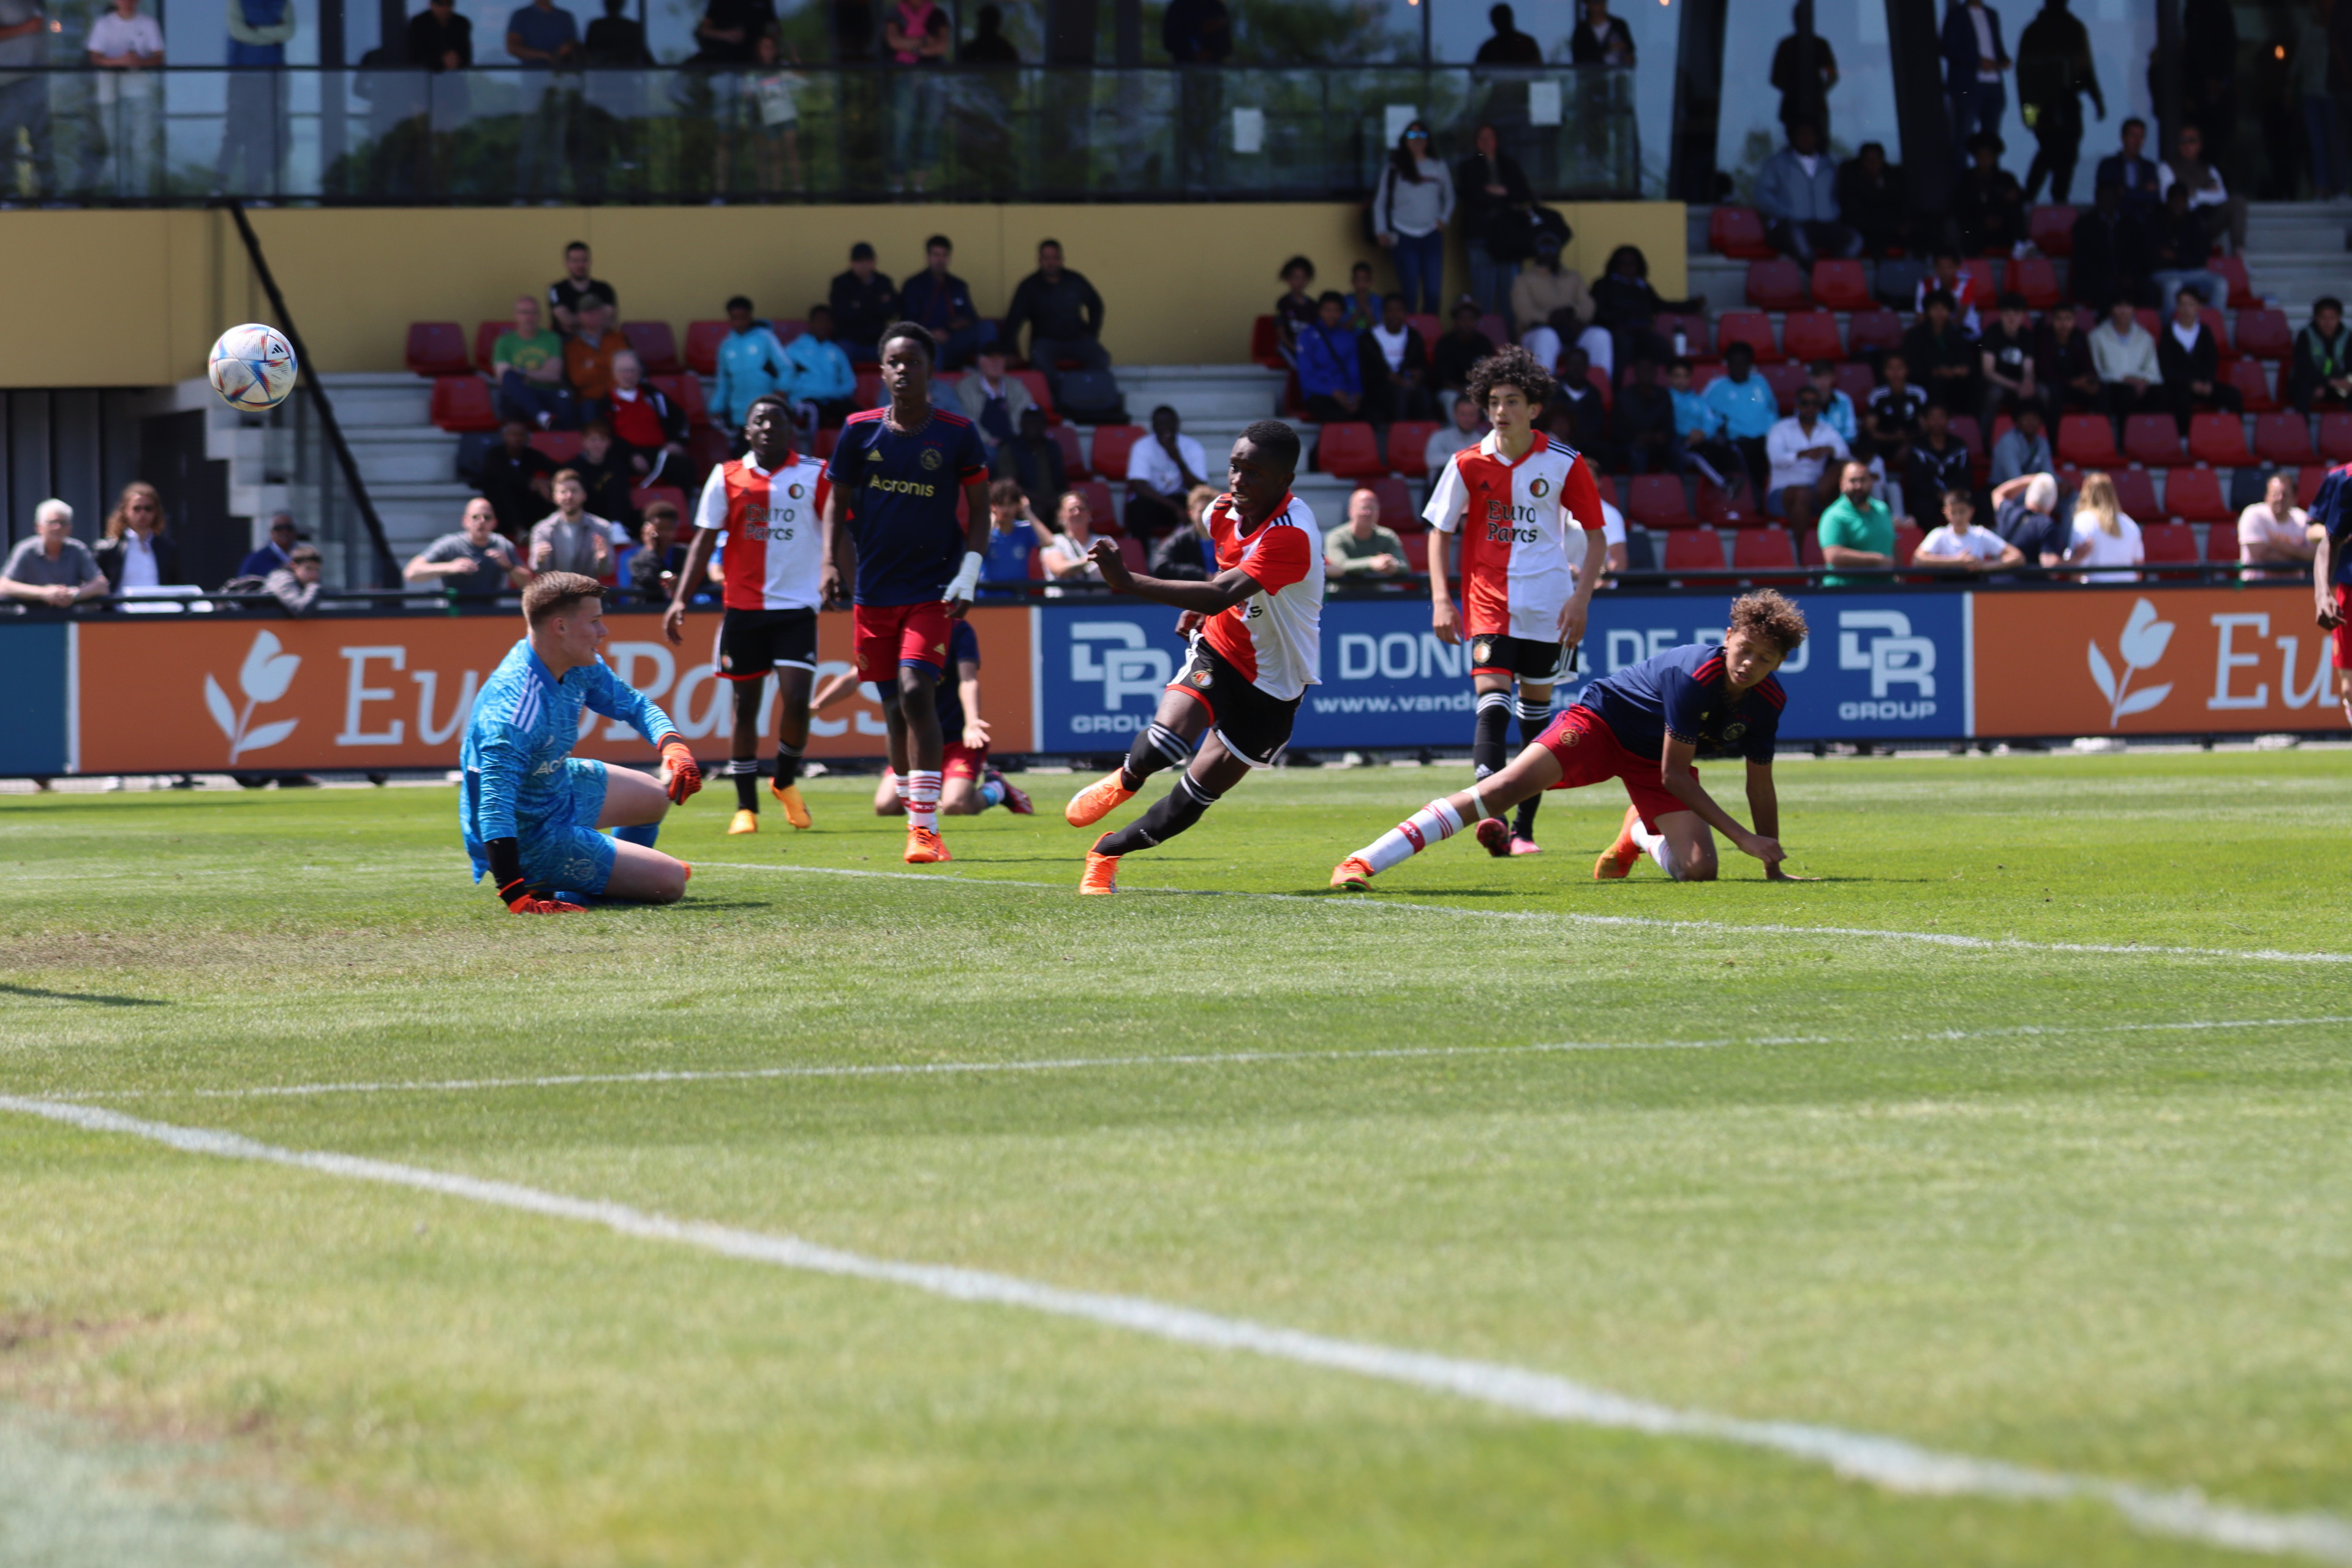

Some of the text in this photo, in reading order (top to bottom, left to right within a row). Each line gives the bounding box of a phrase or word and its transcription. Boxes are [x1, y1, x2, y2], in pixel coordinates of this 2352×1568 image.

[869, 473, 935, 497] Acronis
[744, 503, 796, 522] Euro
[1486, 500, 1536, 524] Euro
[744, 523, 794, 541] Parcs
[1486, 523, 1538, 543] Parcs
[1339, 632, 1474, 679] DON
[1839, 701, 1937, 720] GROUP
[1071, 714, 1155, 734] GROU
